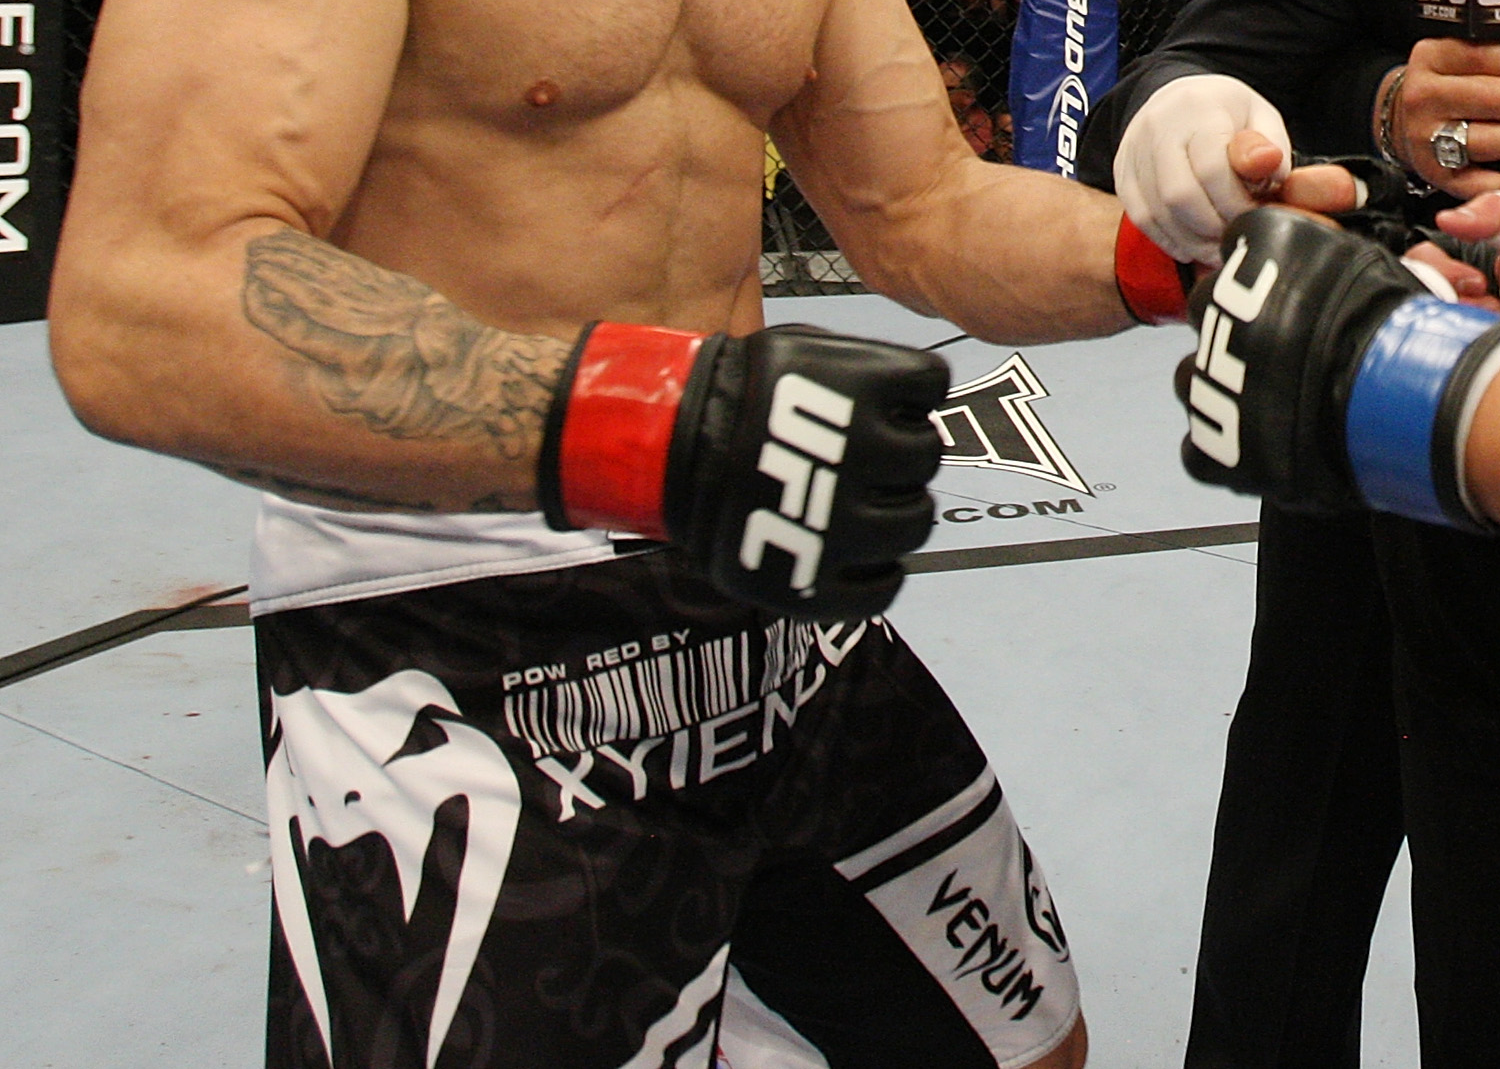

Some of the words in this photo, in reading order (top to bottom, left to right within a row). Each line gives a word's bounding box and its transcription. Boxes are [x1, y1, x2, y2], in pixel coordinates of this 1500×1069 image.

[1056, 87, 1083, 179] LIGH
[1189, 243, 1279, 468] UFC
[739, 373, 855, 590] UFC
[651, 628, 689, 651] BY
[926, 869, 1045, 1021] VENUM
